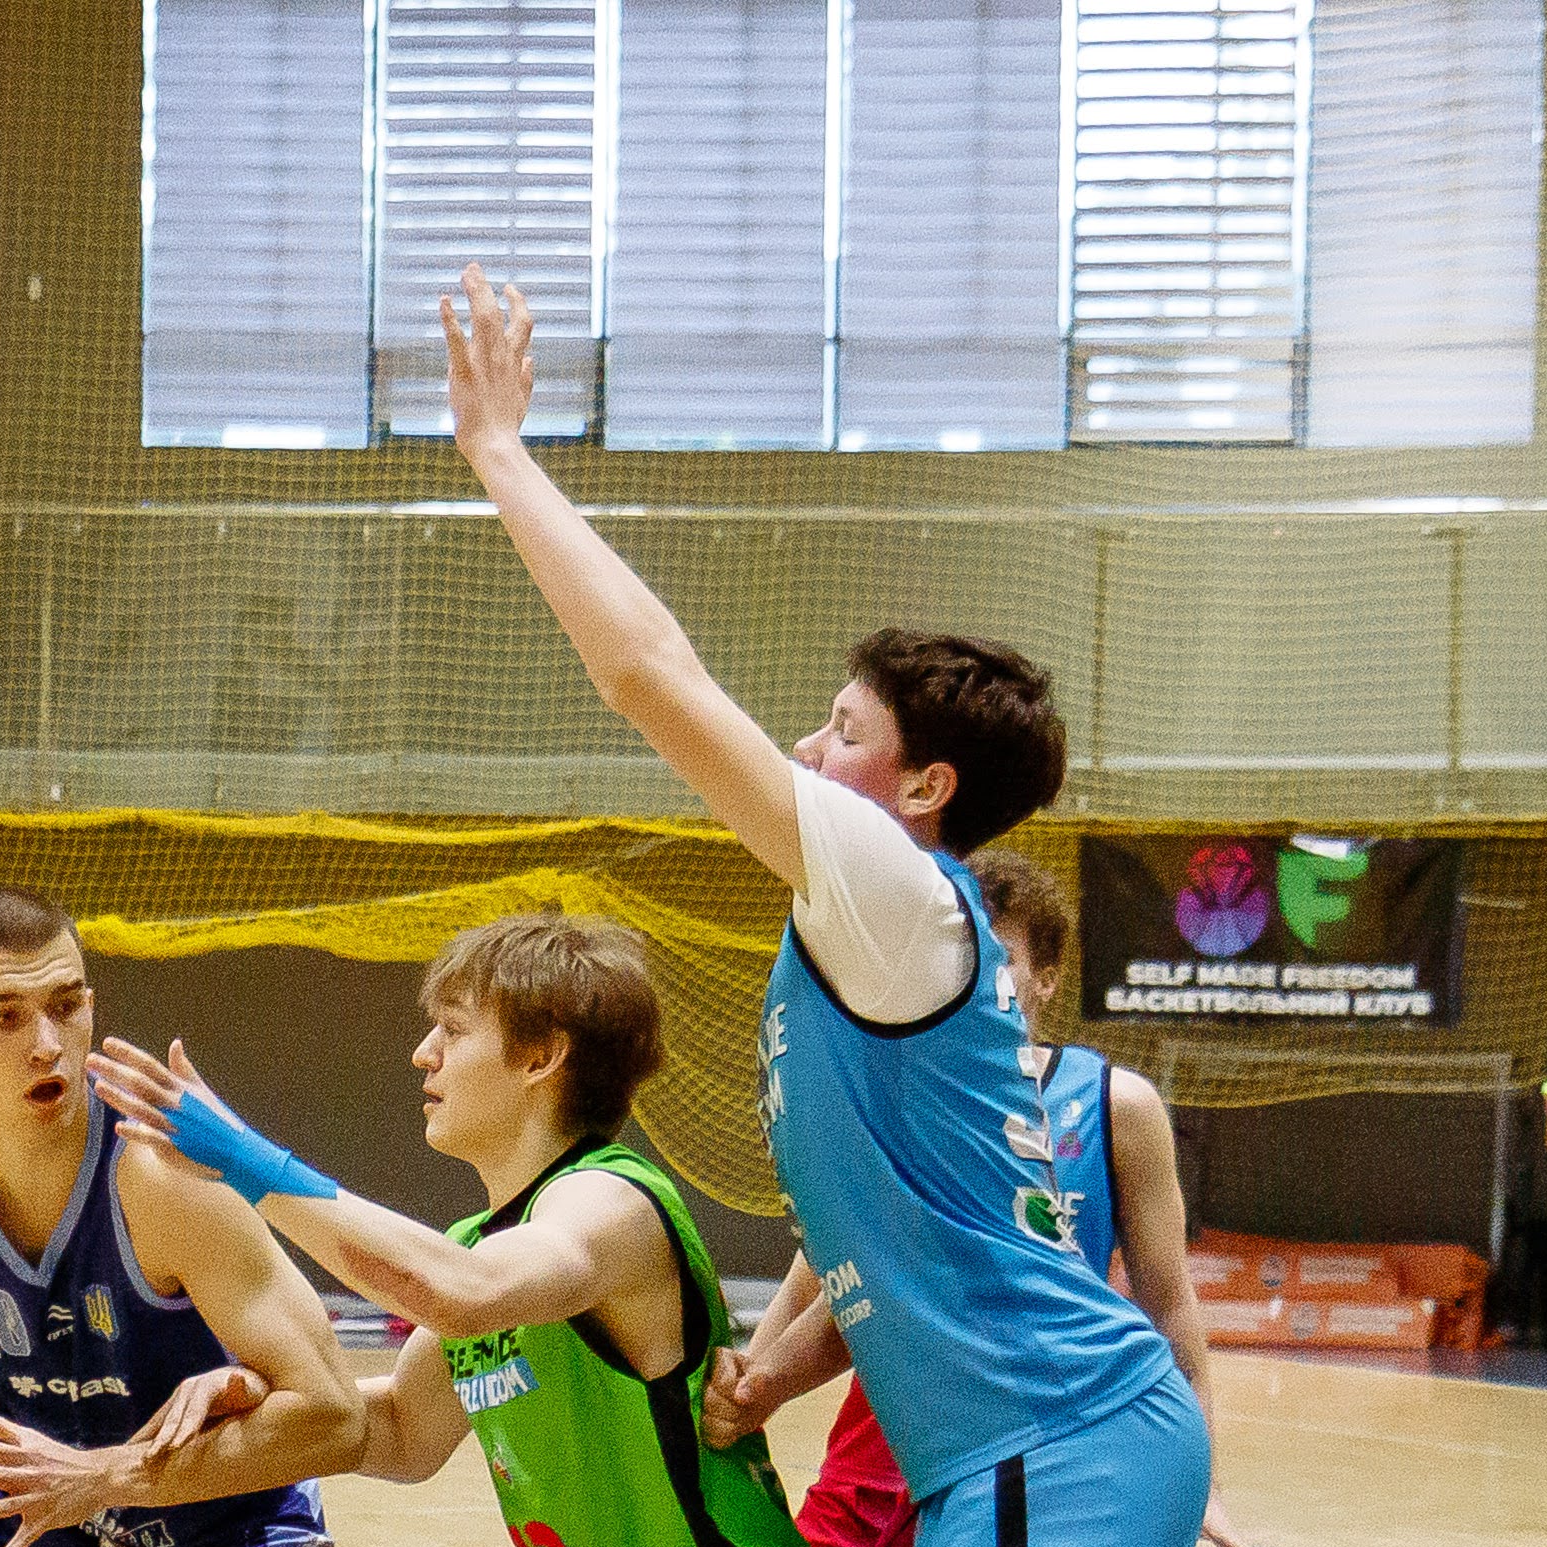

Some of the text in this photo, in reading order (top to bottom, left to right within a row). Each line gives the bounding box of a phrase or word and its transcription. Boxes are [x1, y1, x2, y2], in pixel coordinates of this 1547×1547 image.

[1126, 960, 1417, 990] SELF MADE FREEDOM
[1354, 991, 1434, 1016] КЛУБ
